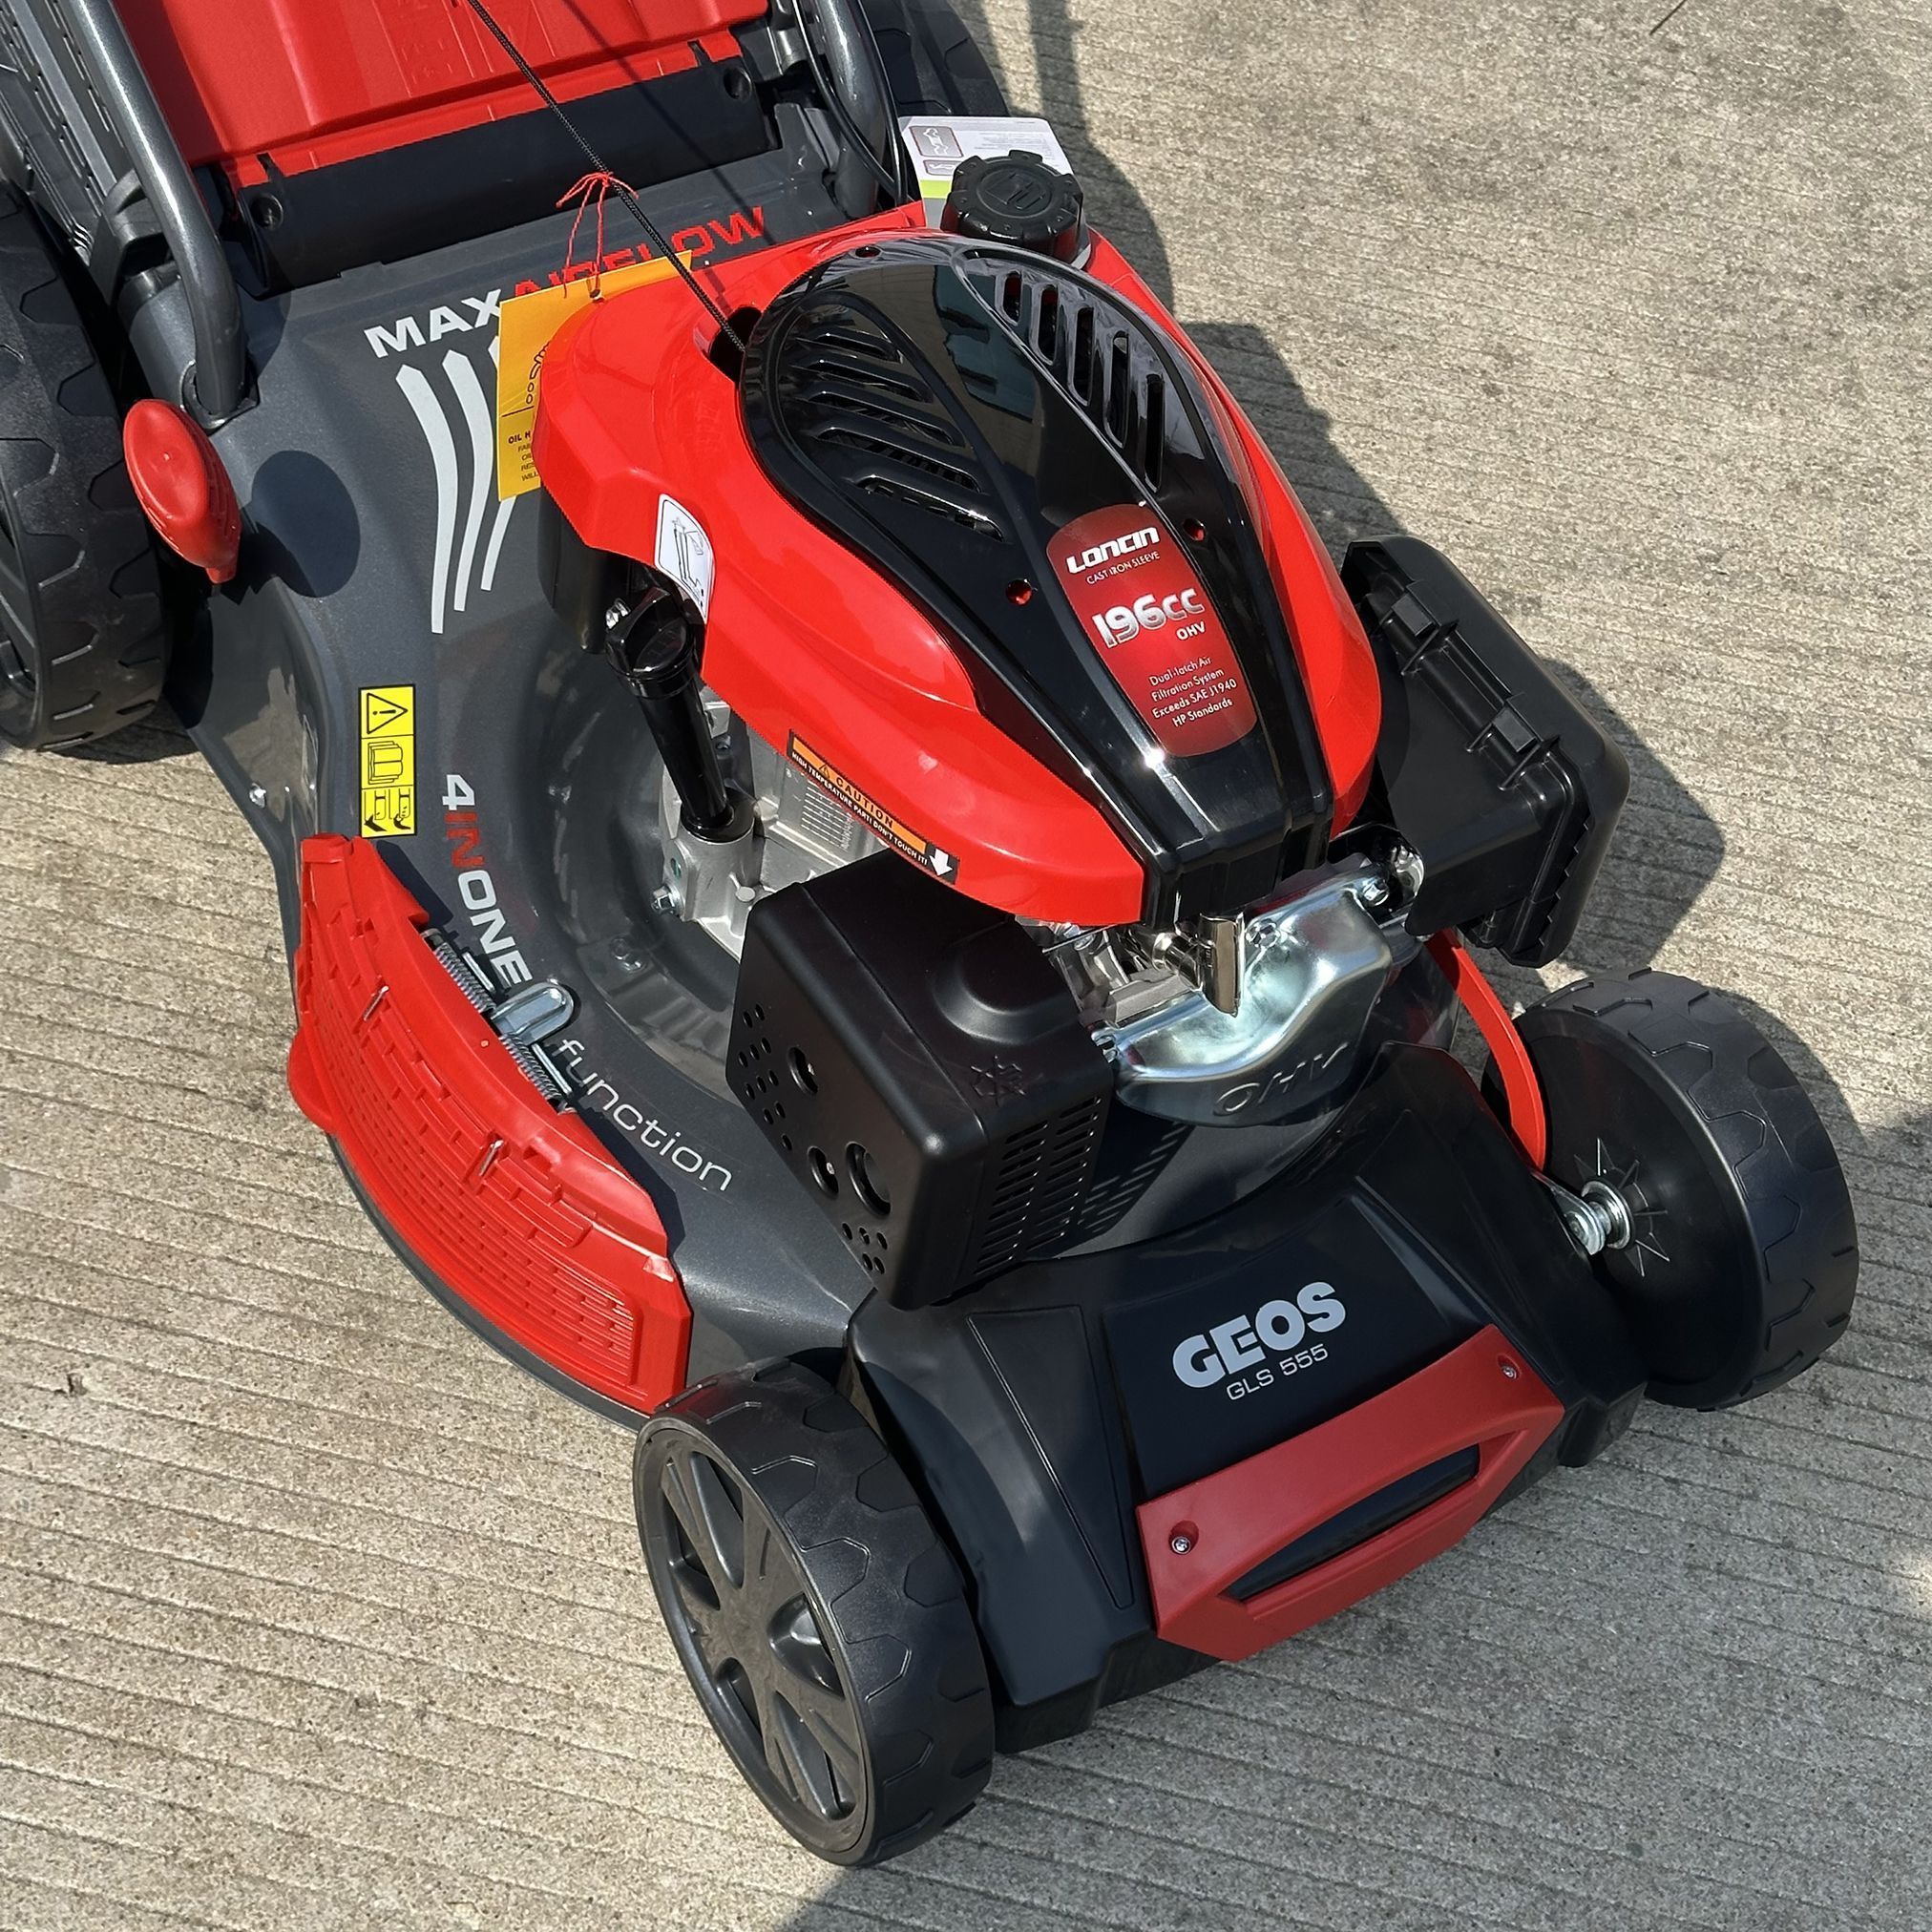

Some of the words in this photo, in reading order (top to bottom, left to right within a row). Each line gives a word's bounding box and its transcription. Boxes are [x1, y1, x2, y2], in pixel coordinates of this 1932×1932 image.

[364, 289, 501, 359] MAX
[508, 433, 522, 444] OIL
[1086, 570, 1108, 584] CAST
[1109, 561, 1132, 577] IRON
[1132, 551, 1161, 568] SLEEVE
[1092, 588, 1206, 649] 196cc
[1176, 620, 1206, 640] OHV
[1198, 656, 1212, 667] Air
[1151, 680, 1193, 703] Filtration
[1193, 668, 1225, 687] System
[1152, 697, 1191, 720] Exceeds
[1191, 690, 1209, 704] SAE
[1209, 678, 1237, 698] J1940
[1172, 713, 1187, 727] HP
[1188, 697, 1233, 723] Standards
[791, 751, 808, 769] HIGH
[808, 765, 852, 808] TEMPERATURE
[873, 821, 893, 841] DON'T
[893, 836, 918, 861] TOUCH
[836, 777, 893, 829] CAUTION
[552, 1038, 733, 1192] function
[1172, 1281, 1347, 1389] GEOS
[1226, 1368, 1275, 1400] GLS
[1279, 1343, 1329, 1376] 555
